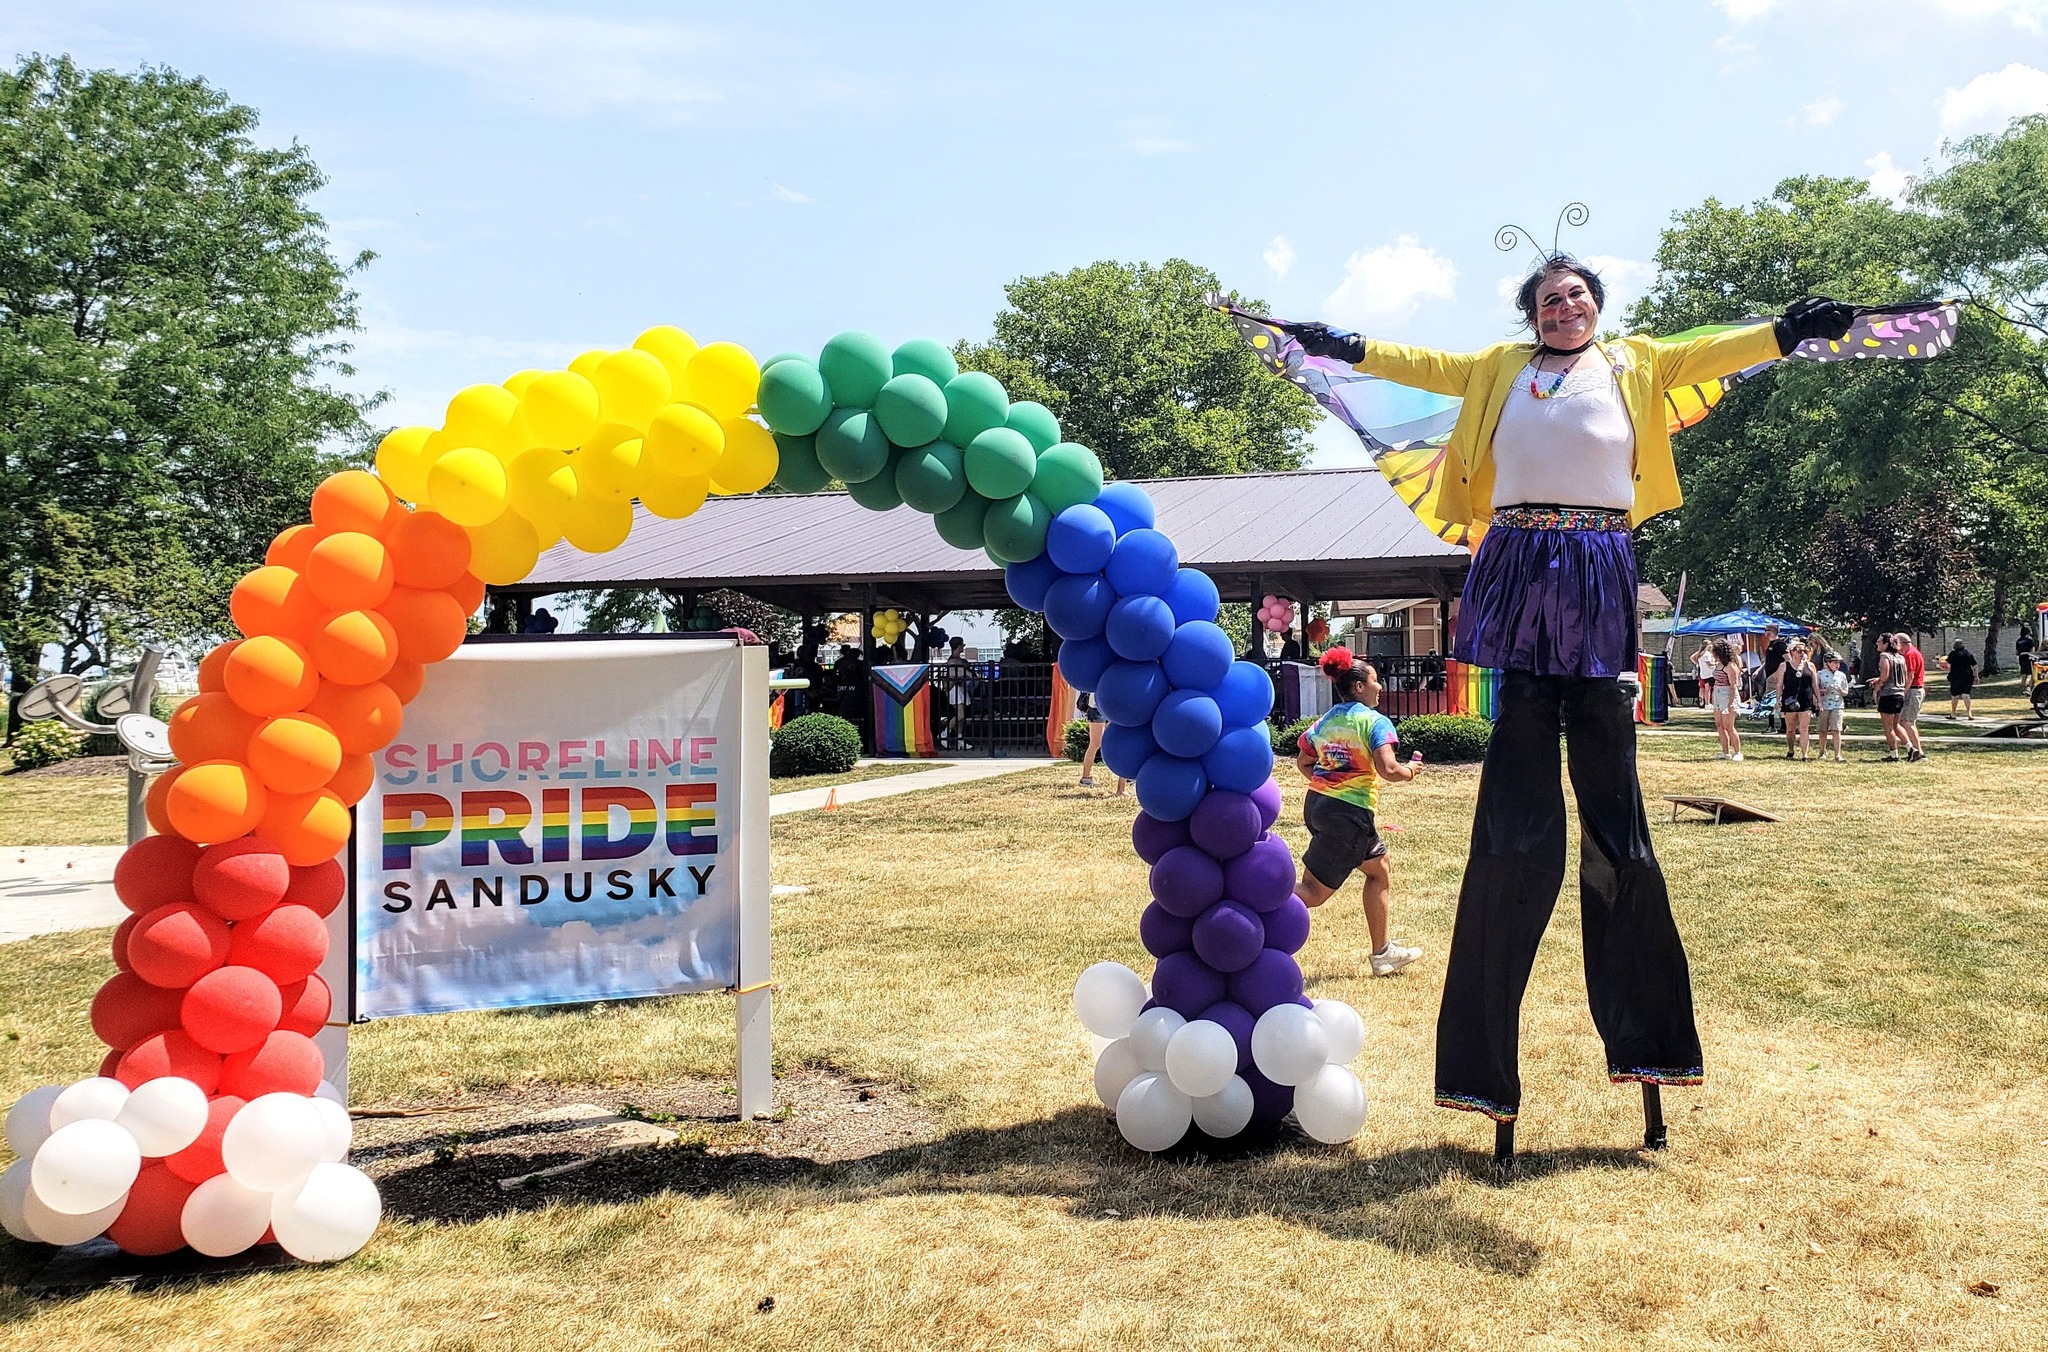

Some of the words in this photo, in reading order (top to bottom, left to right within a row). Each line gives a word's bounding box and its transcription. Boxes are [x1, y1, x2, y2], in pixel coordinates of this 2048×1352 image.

[383, 737, 718, 786] SHORELINE
[382, 783, 718, 871] PRIDE
[382, 865, 716, 914] SANDUSKY
